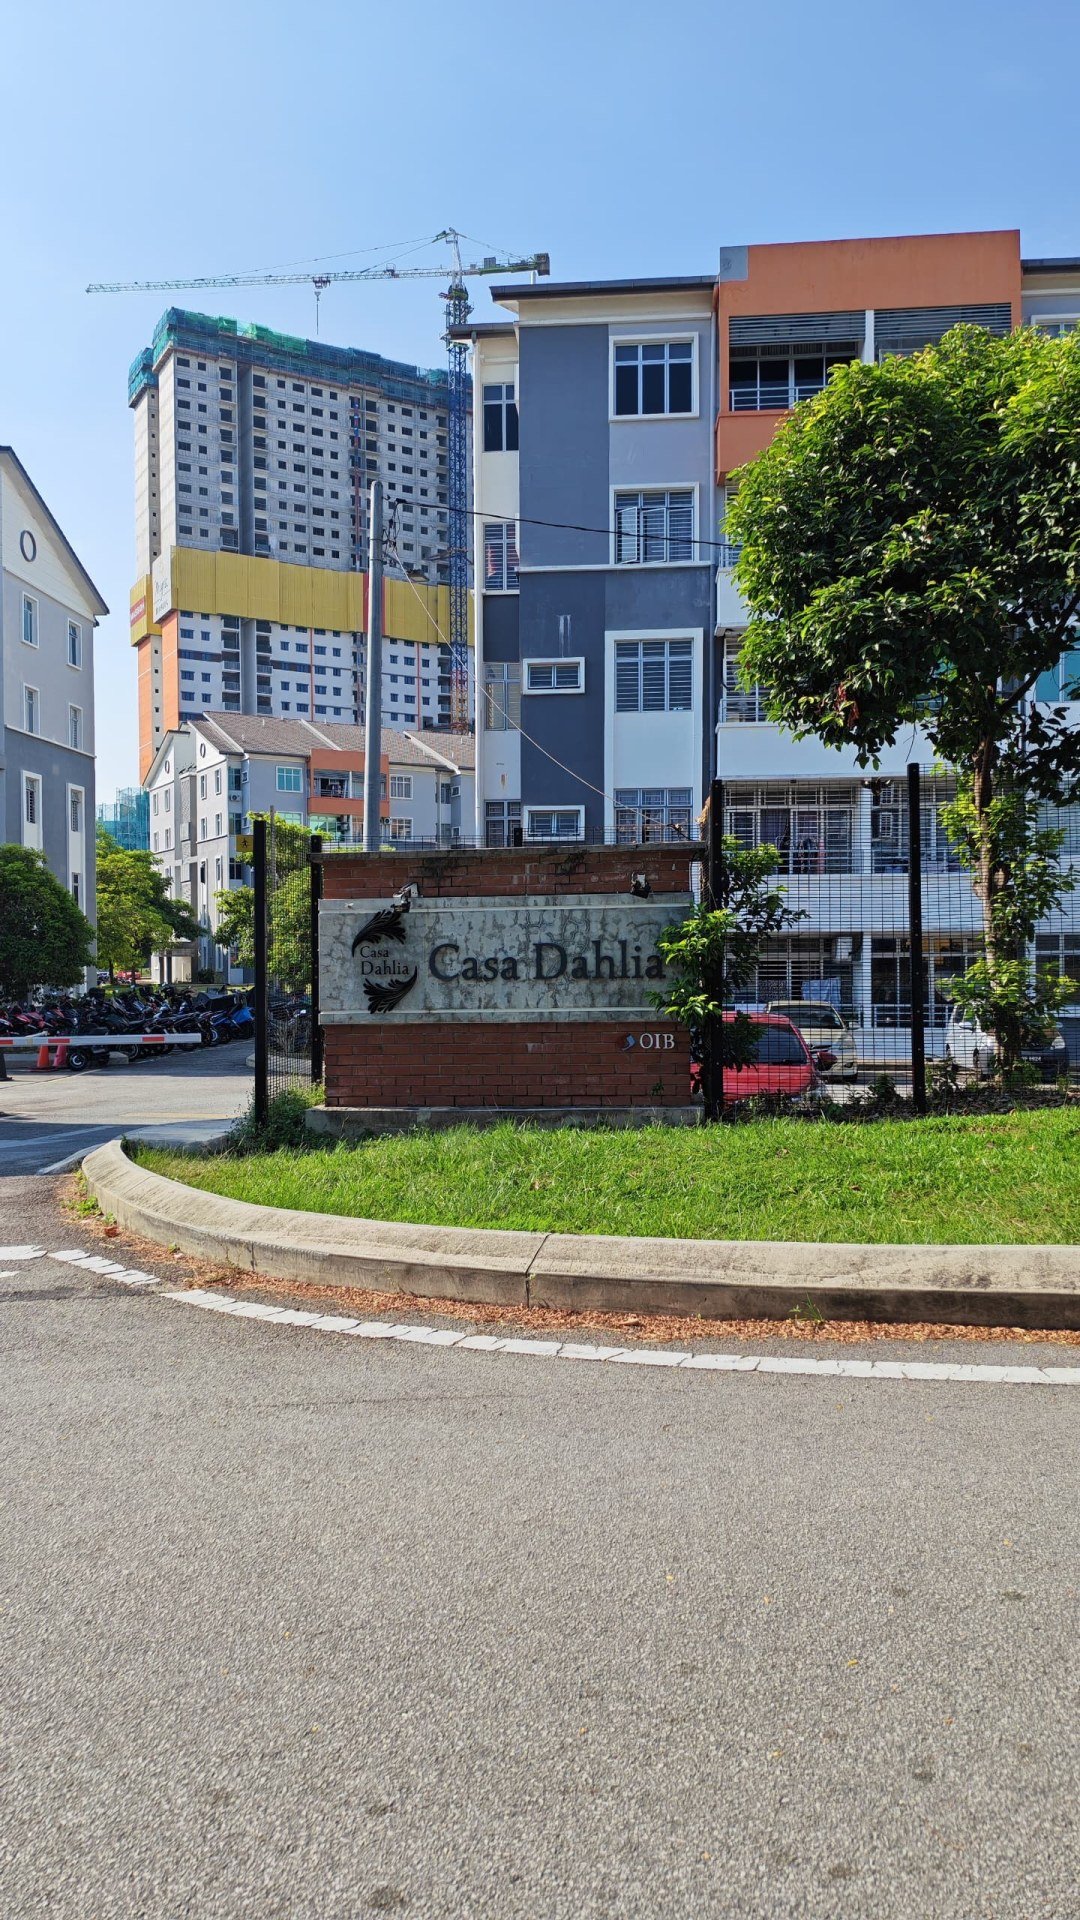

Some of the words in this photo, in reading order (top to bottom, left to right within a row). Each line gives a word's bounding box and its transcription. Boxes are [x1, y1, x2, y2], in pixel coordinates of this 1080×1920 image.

[360, 945, 389, 958] Casa
[361, 960, 409, 975] Dahlia
[428, 943, 520, 981] Casa
[533, 939, 667, 981] Dahlia
[639, 1033, 675, 1049] OIB
